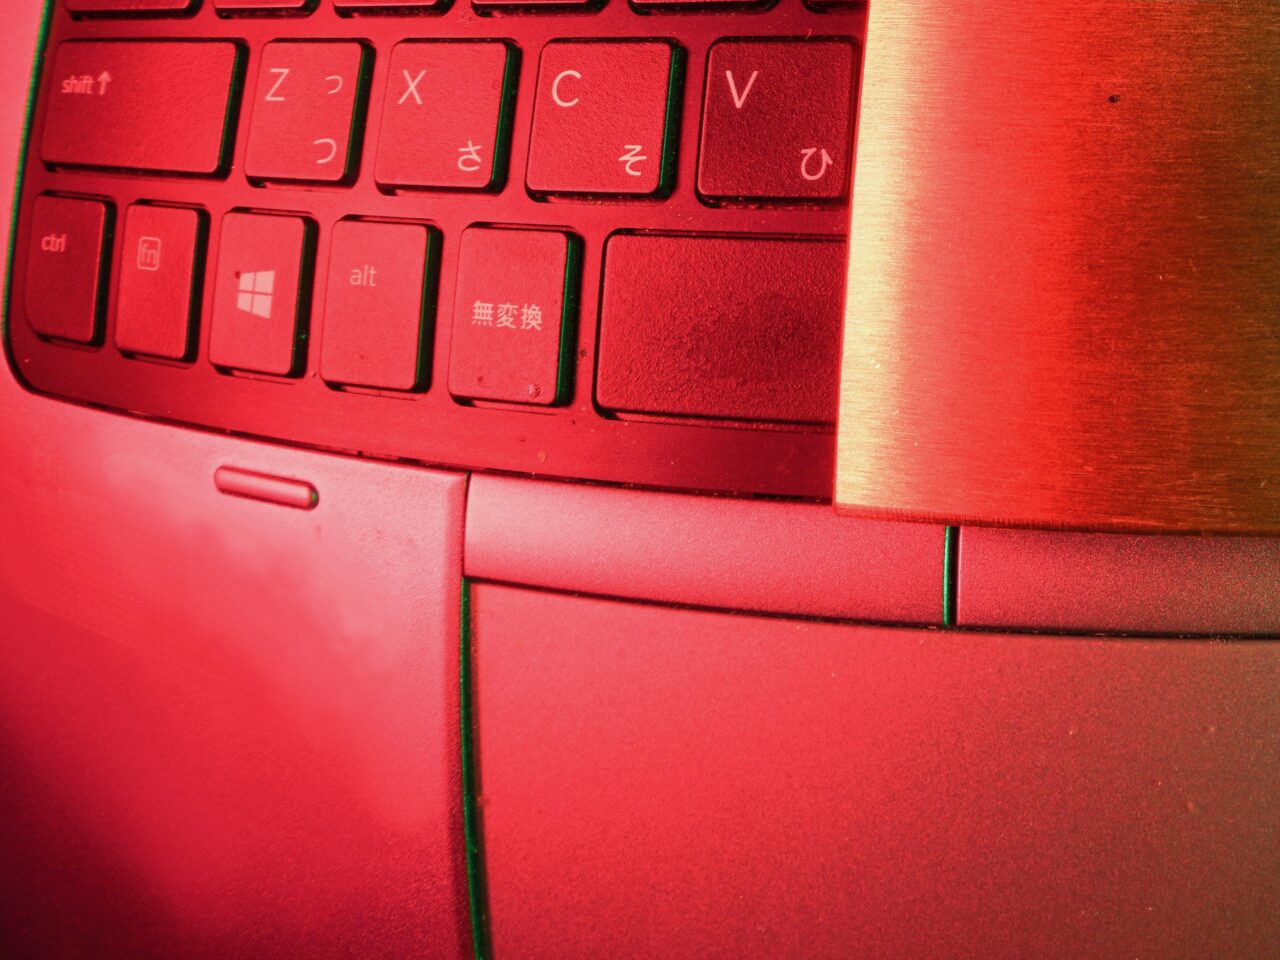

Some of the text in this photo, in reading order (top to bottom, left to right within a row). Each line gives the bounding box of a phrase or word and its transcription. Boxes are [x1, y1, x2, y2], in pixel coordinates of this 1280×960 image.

[62, 75, 94, 94] shift
[265, 68, 289, 101] Z
[398, 70, 426, 104] X
[552, 70, 581, 107] C
[726, 71, 758, 108] V
[314, 138, 336, 163] つ
[458, 141, 481, 171] さ
[619, 145, 647, 175] そ
[801, 148, 833, 180] ひ
[42, 234, 66, 252] ctrl
[141, 244, 158, 264] fn
[350, 265, 376, 286] alt
[472, 300, 542, 330] 無変換
